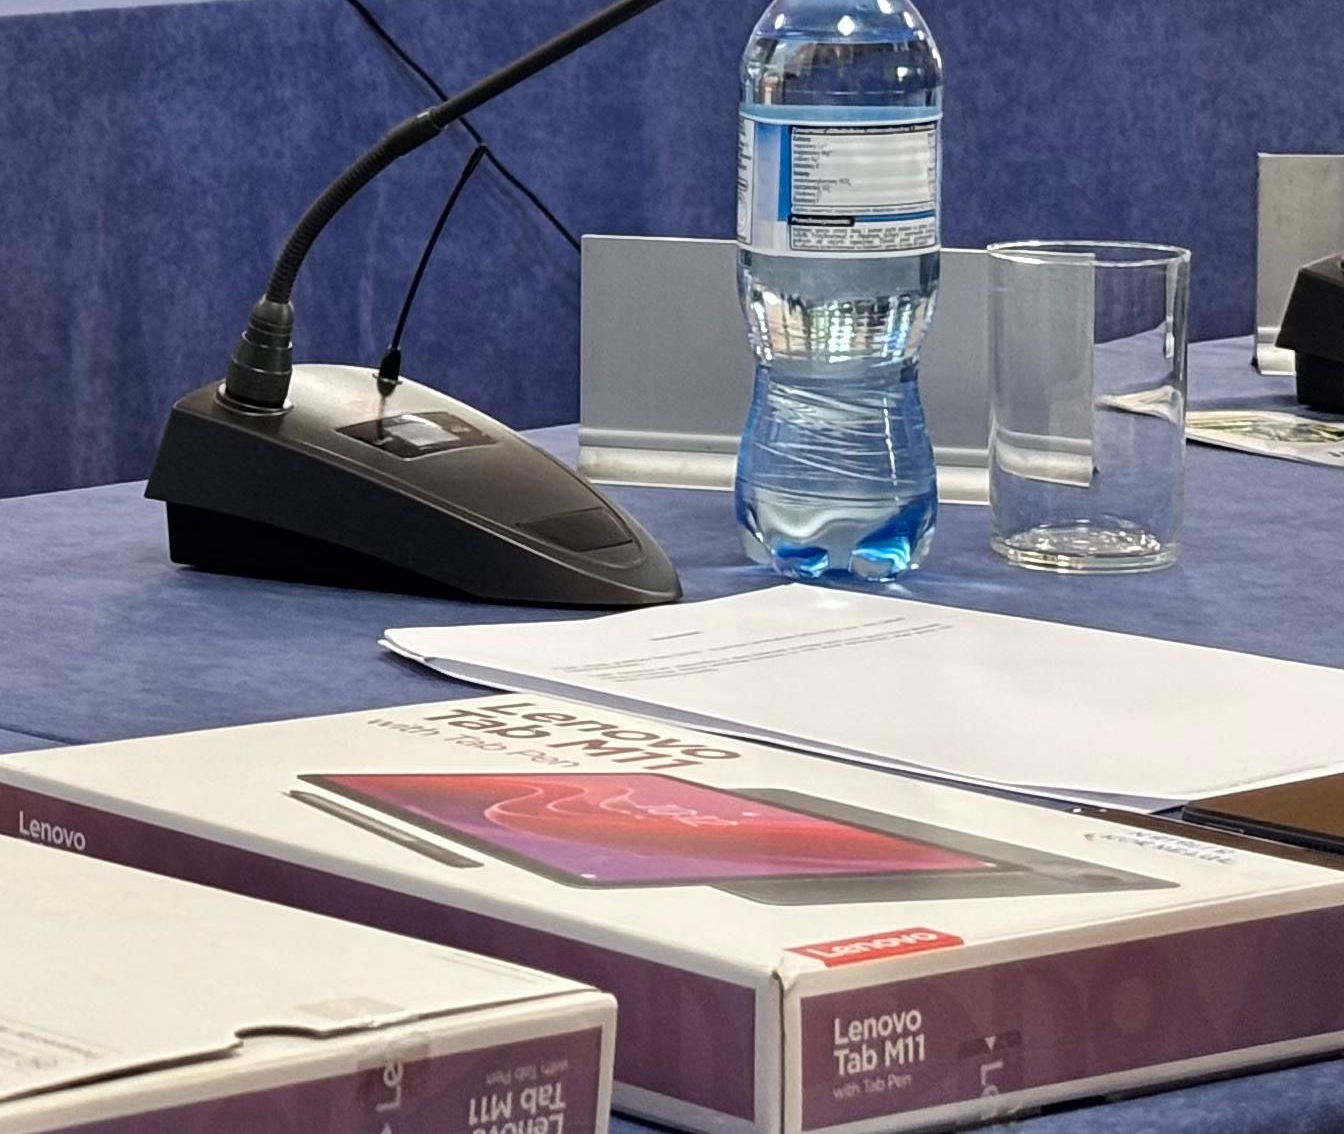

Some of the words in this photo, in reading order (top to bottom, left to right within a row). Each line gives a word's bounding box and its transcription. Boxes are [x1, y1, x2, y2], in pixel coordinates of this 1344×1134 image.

[367, 717, 440, 737] with
[443, 733, 507, 753] Tab
[504, 748, 581, 768] Pen
[423, 708, 552, 739] Tab
[547, 738, 706, 771] M11
[477, 702, 742, 760] Lenovo
[19, 810, 86, 851] Lenovo
[805, 931, 939, 958] Lenovo
[834, 1008, 923, 1046] Lenovo
[834, 1044, 878, 1077] Tab
[884, 1033, 926, 1067] M11
[520, 1081, 566, 1114] Tab
[833, 1083, 860, 1100] with
[863, 1076, 886, 1094] Tab
[887, 1072, 912, 1089] Pen
[467, 1090, 513, 1126] M11
